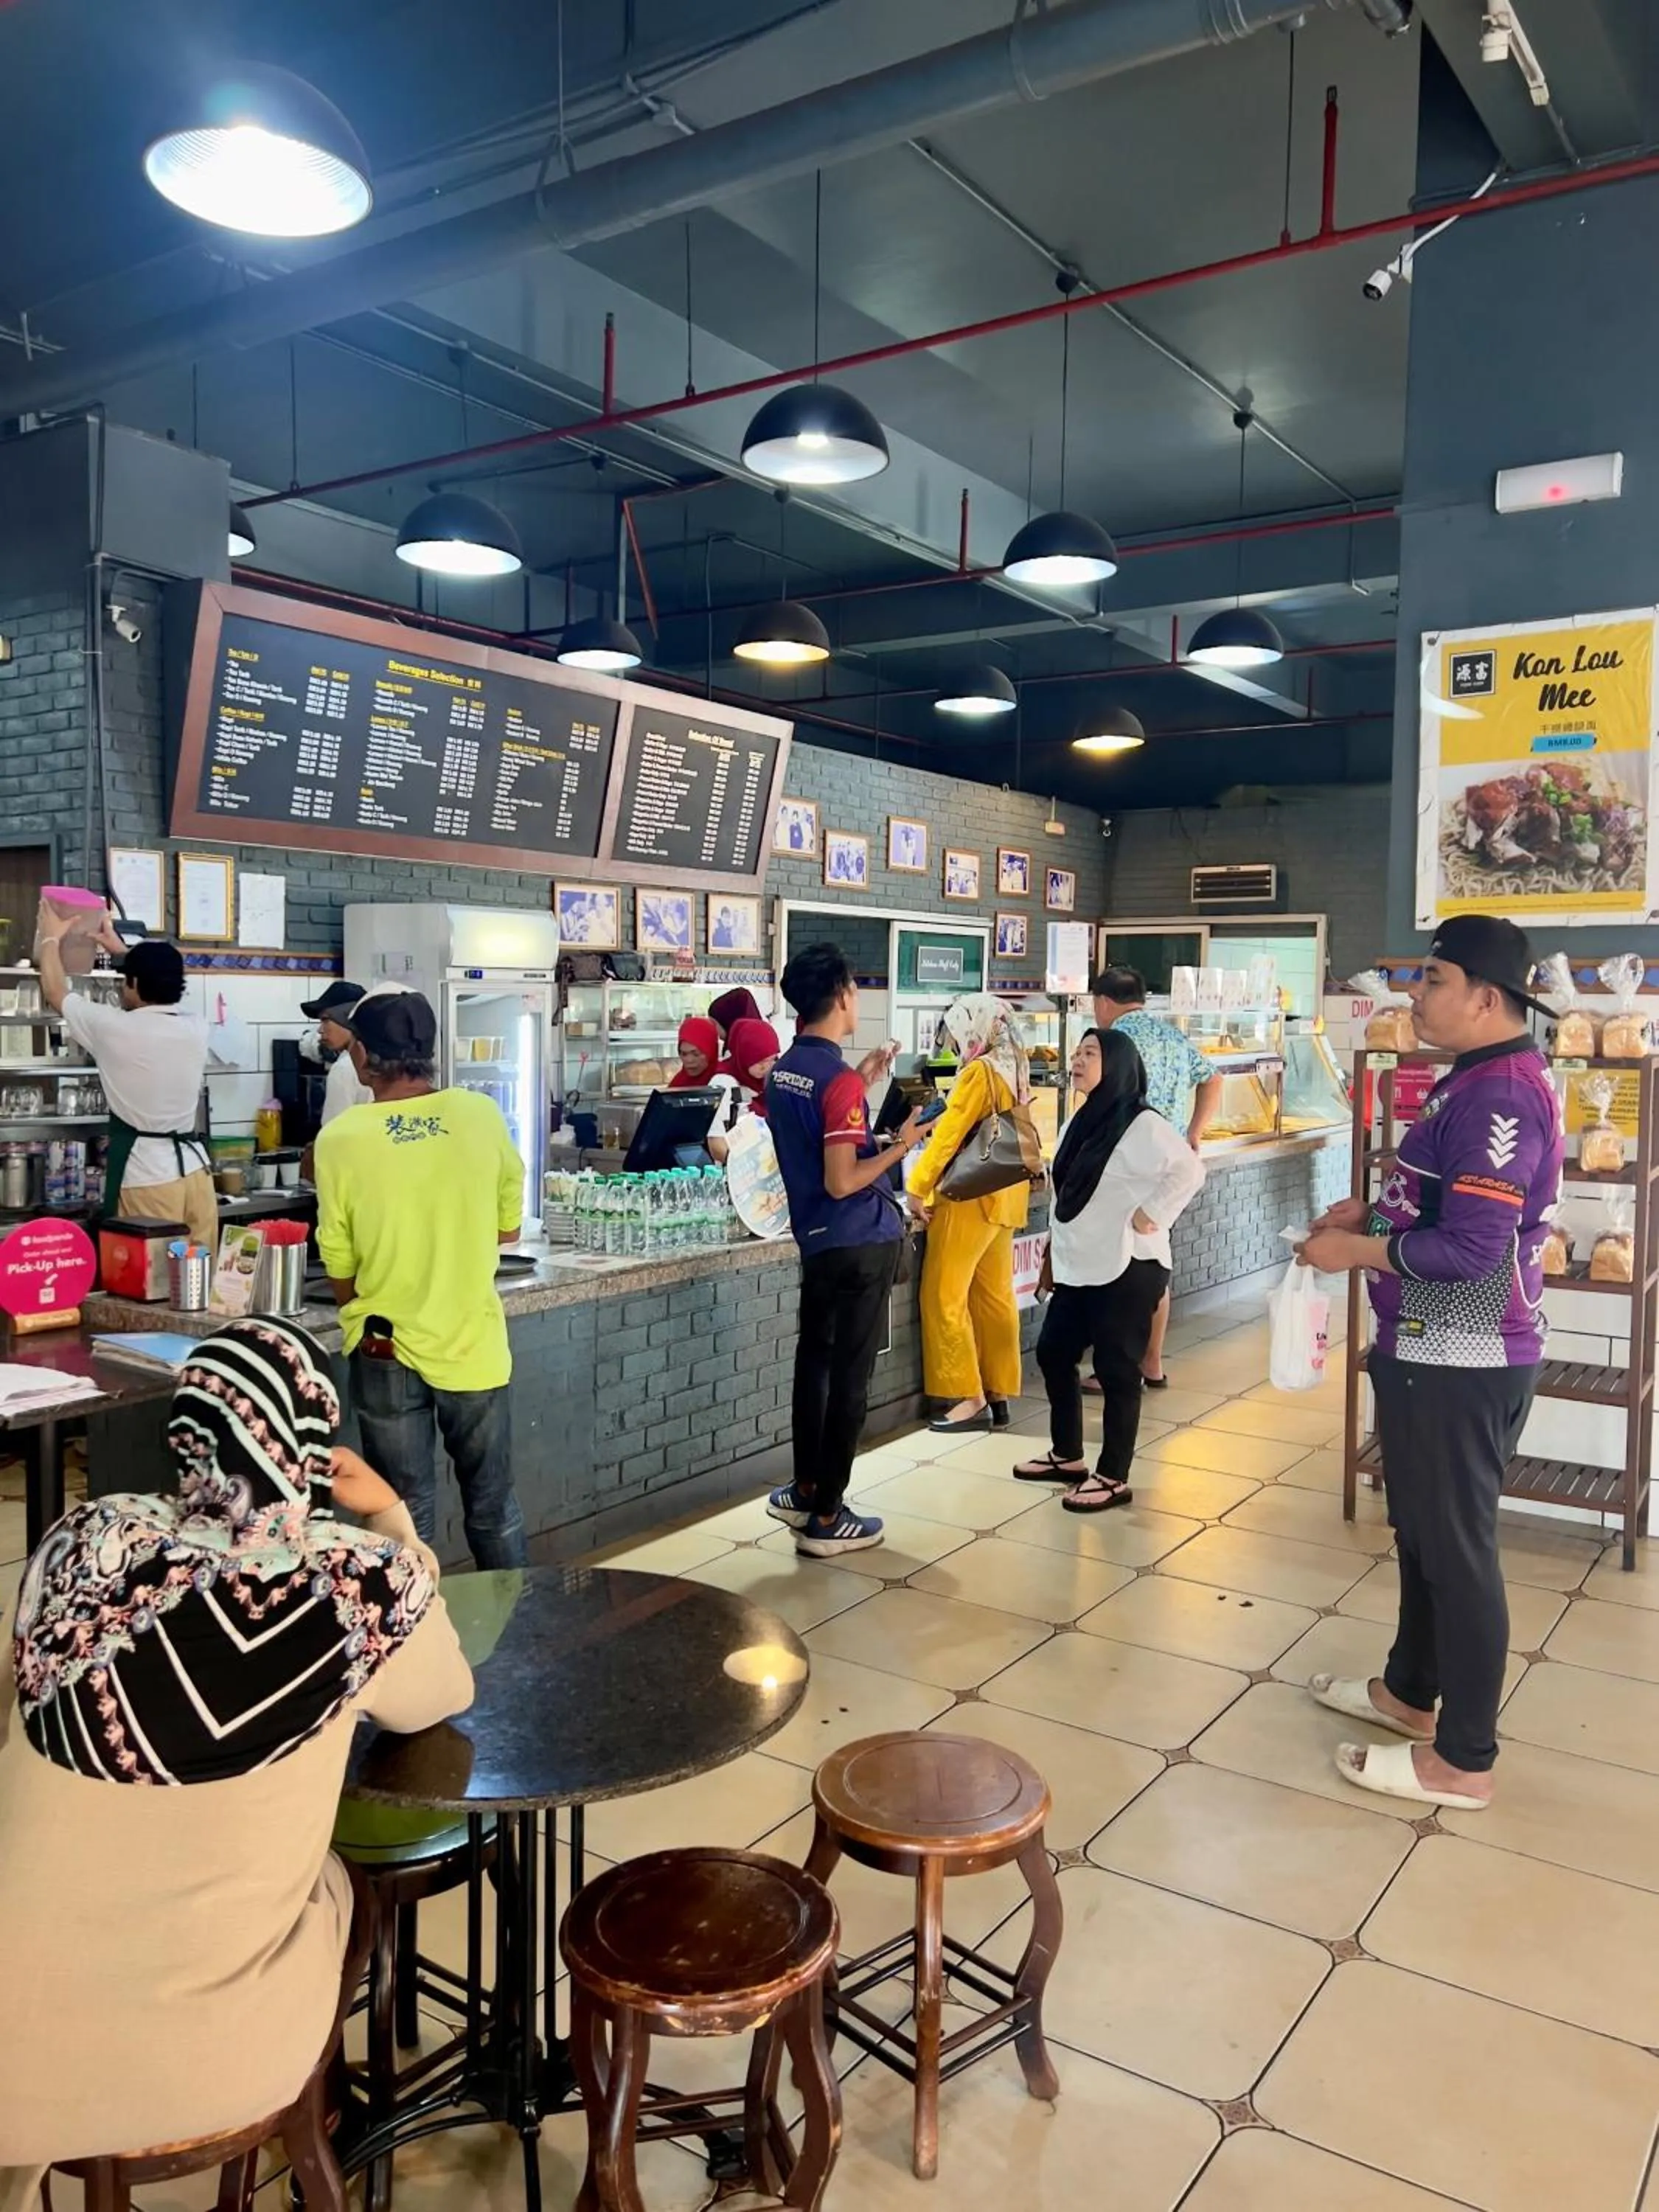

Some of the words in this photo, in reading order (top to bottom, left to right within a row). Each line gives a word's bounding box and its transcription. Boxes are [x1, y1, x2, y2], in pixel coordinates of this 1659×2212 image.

[389, 660, 429, 678] Beverages
[430, 669, 464, 684] Selection
[1538, 682, 1597, 712] Mee
[7, 1260, 54, 1275] Pick-Up
[56, 1256, 87, 1269] here.
